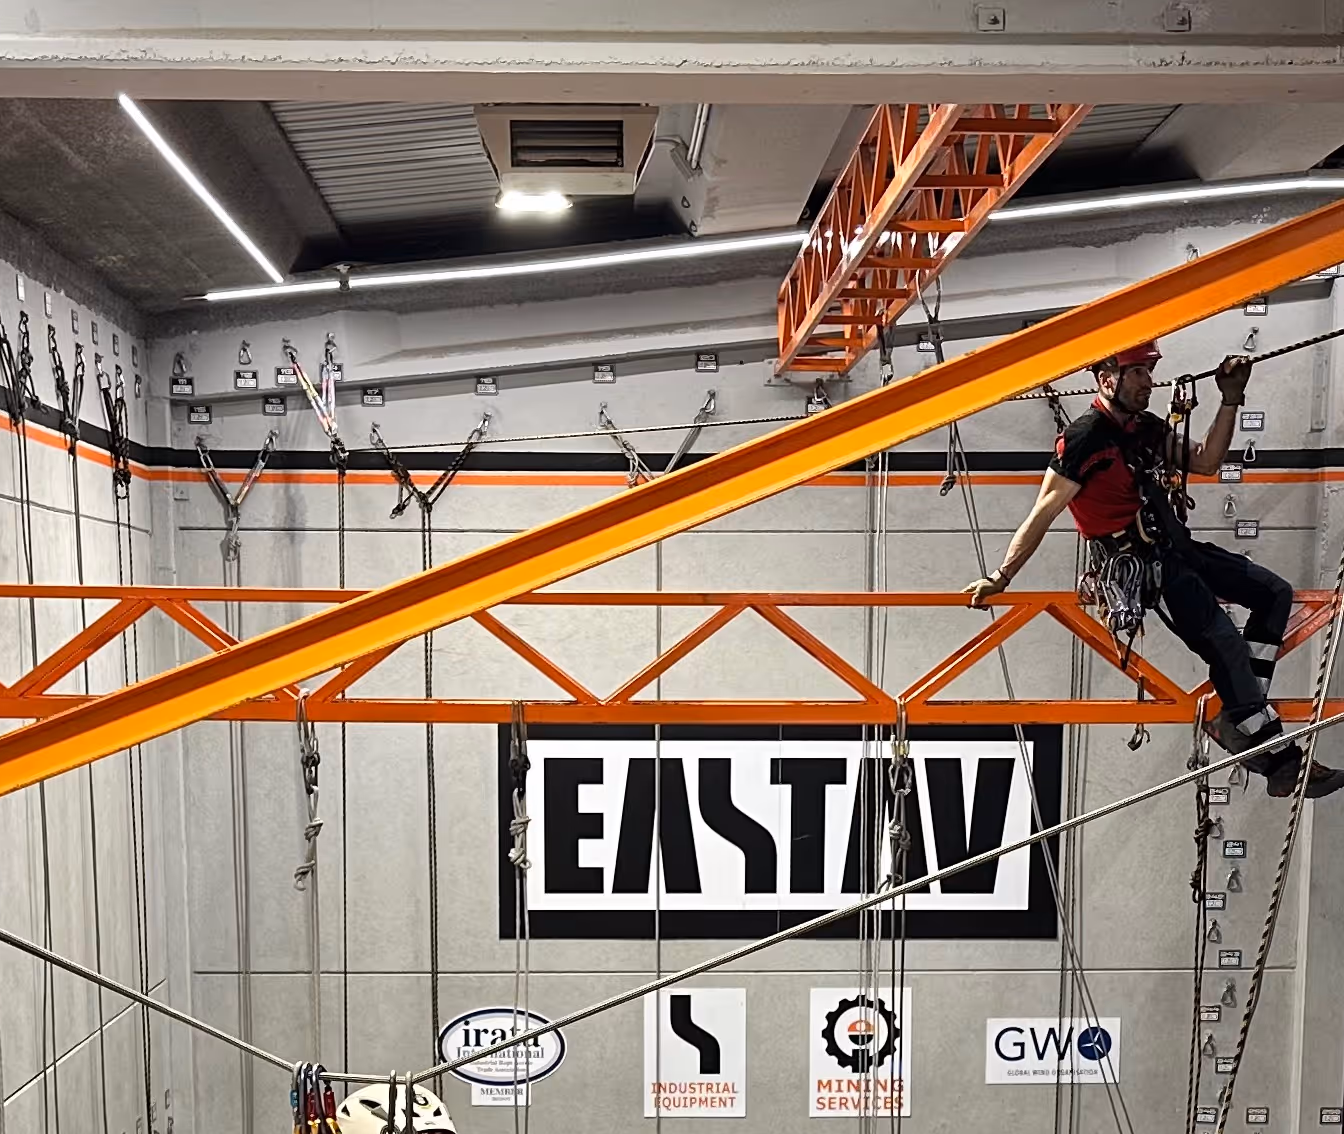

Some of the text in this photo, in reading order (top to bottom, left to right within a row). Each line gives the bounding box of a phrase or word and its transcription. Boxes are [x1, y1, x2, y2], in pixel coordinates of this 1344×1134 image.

[544, 758, 1015, 894] EASTAV
[651, 1082, 739, 1095] INDUSTRIAL
[817, 1079, 904, 1093] MINING
[654, 1097, 736, 1109] EQUIPMENT
[816, 1097, 904, 1110] SERVICES
